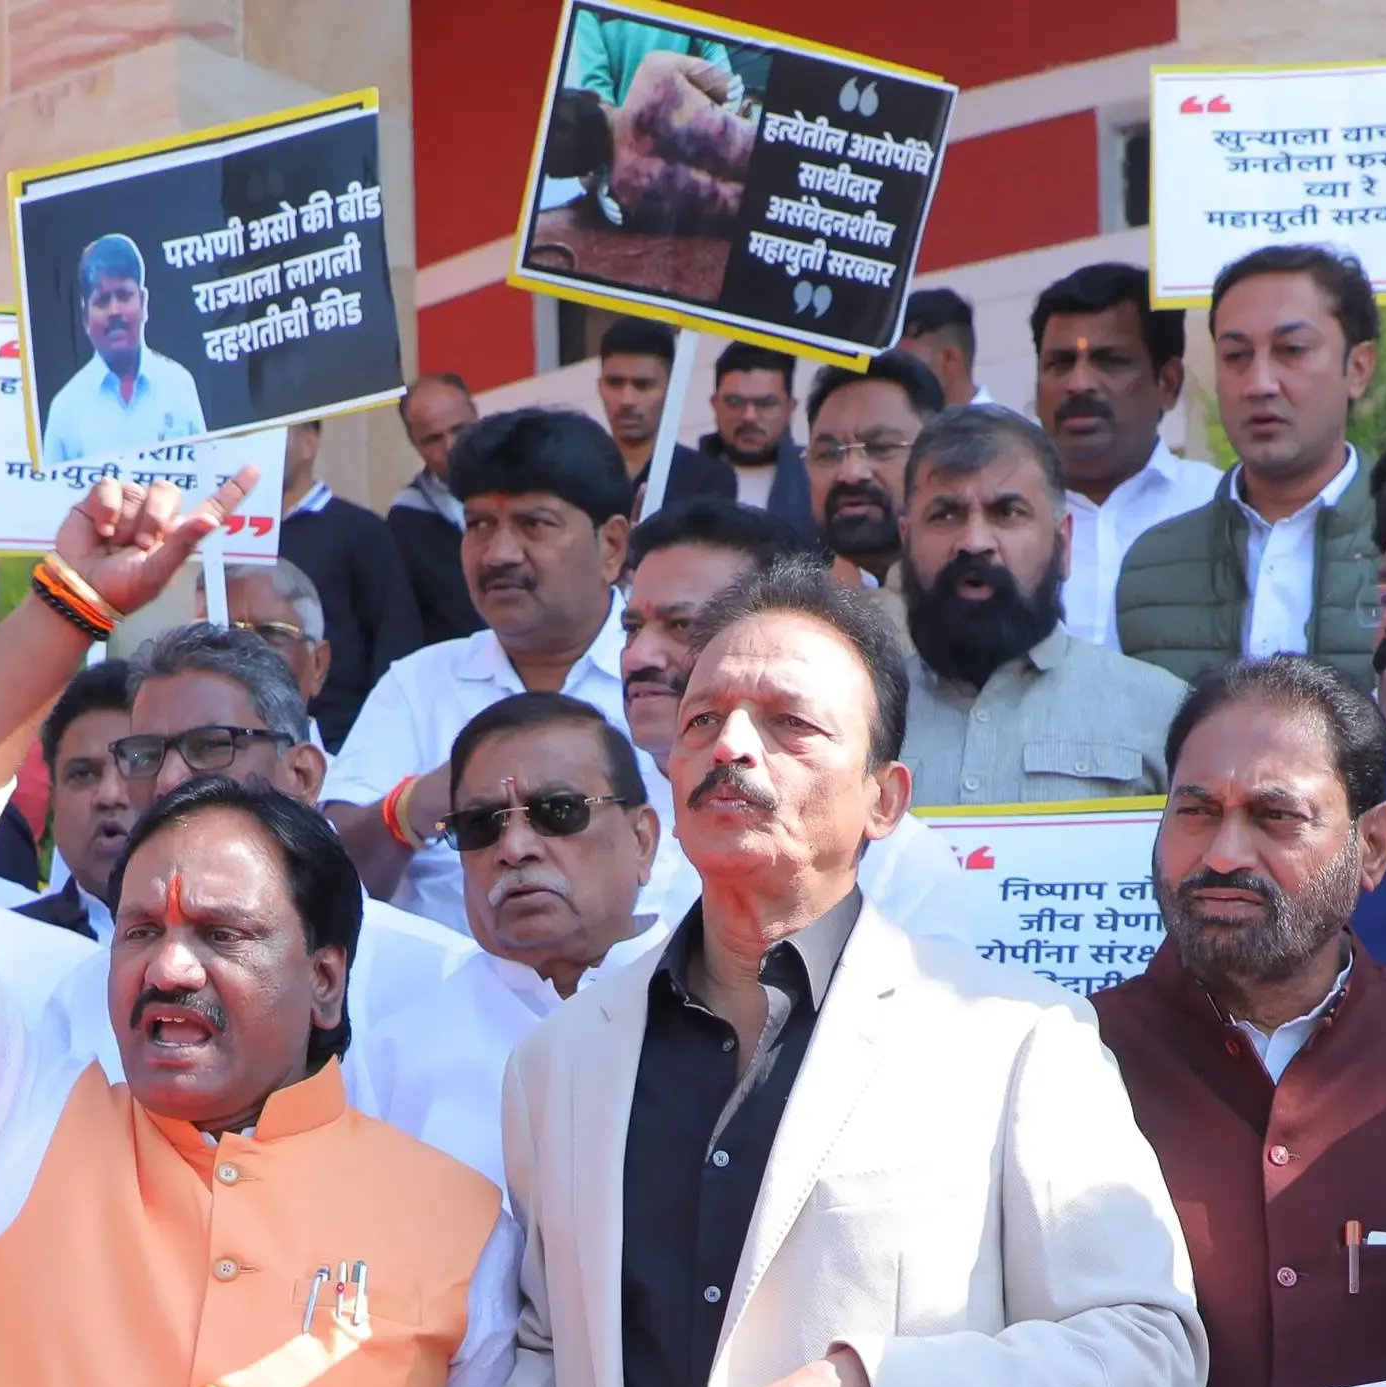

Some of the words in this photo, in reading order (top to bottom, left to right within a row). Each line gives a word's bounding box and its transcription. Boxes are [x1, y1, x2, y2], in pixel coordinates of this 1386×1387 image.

[763, 110, 848, 155] हत्येतील
[1212, 128, 1332, 152] खुन्याला
[798, 161, 883, 204] साथीदार
[1225, 151, 1336, 172] जनतेला
[1361, 174, 1378, 195] रे
[162, 216, 245, 268] परभणी
[248, 200, 297, 250] असो
[299, 190, 333, 233] की
[335, 181, 382, 223] बीड
[765, 195, 897, 247] असंवेदनशील
[1204, 204, 1319, 232] महायुती
[192, 264, 281, 313] राज्याला
[283, 232, 362, 289] लागली
[748, 231, 826, 277] महायुती
[826, 249, 897, 288] सरकार
[203, 297, 309, 362] दहशतीची
[312, 287, 362, 331] कीड
[999, 877, 1108, 901] निष्पाप
[1019, 907, 1085, 932] जीव
